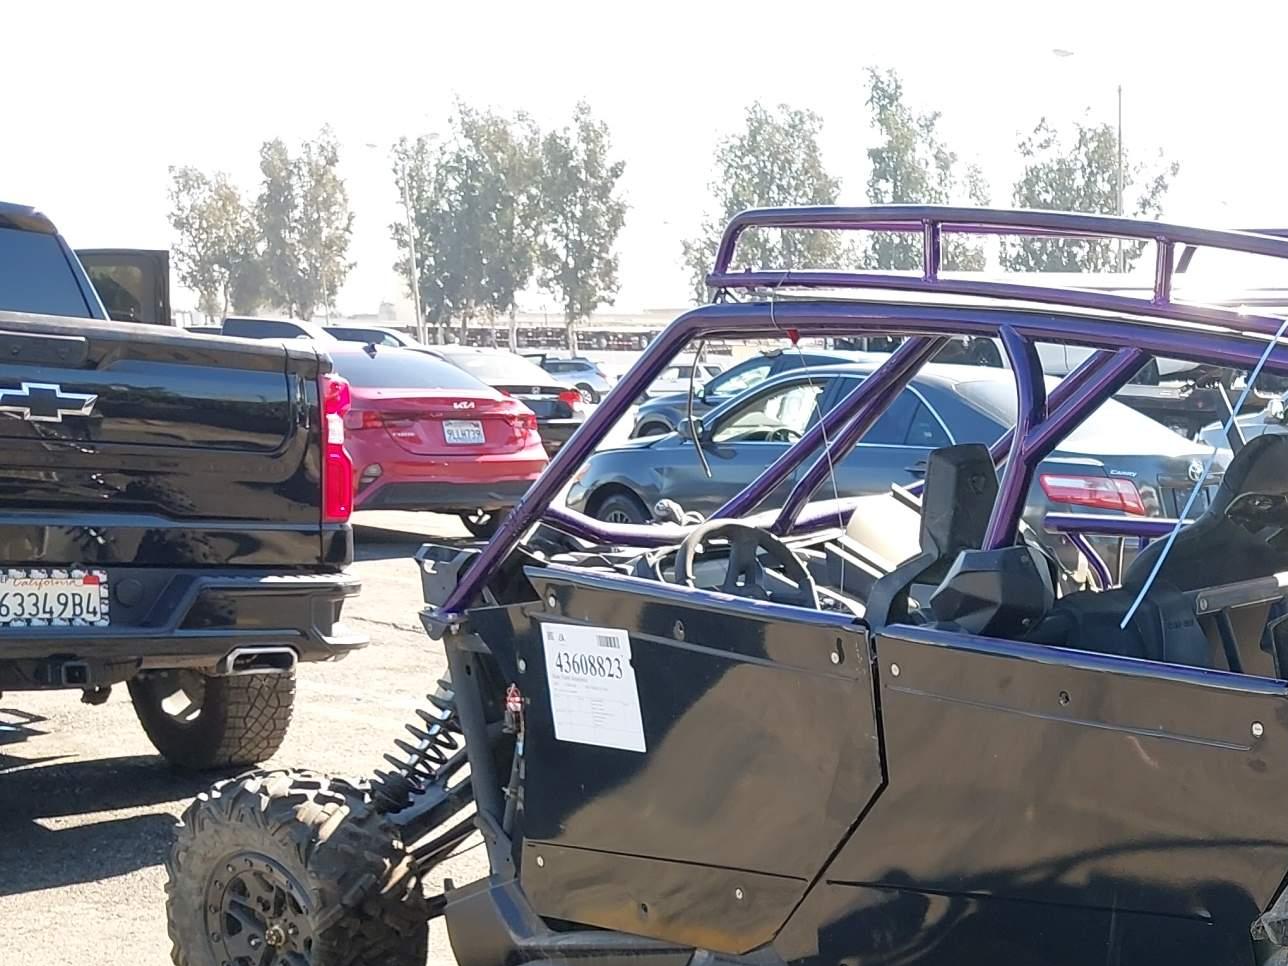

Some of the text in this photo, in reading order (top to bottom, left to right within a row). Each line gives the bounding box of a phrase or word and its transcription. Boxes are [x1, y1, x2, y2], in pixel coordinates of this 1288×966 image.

[453, 401, 475, 409] KIA
[0, 591, 98, 618] 63349B4
[555, 651, 623, 679] 43608823
